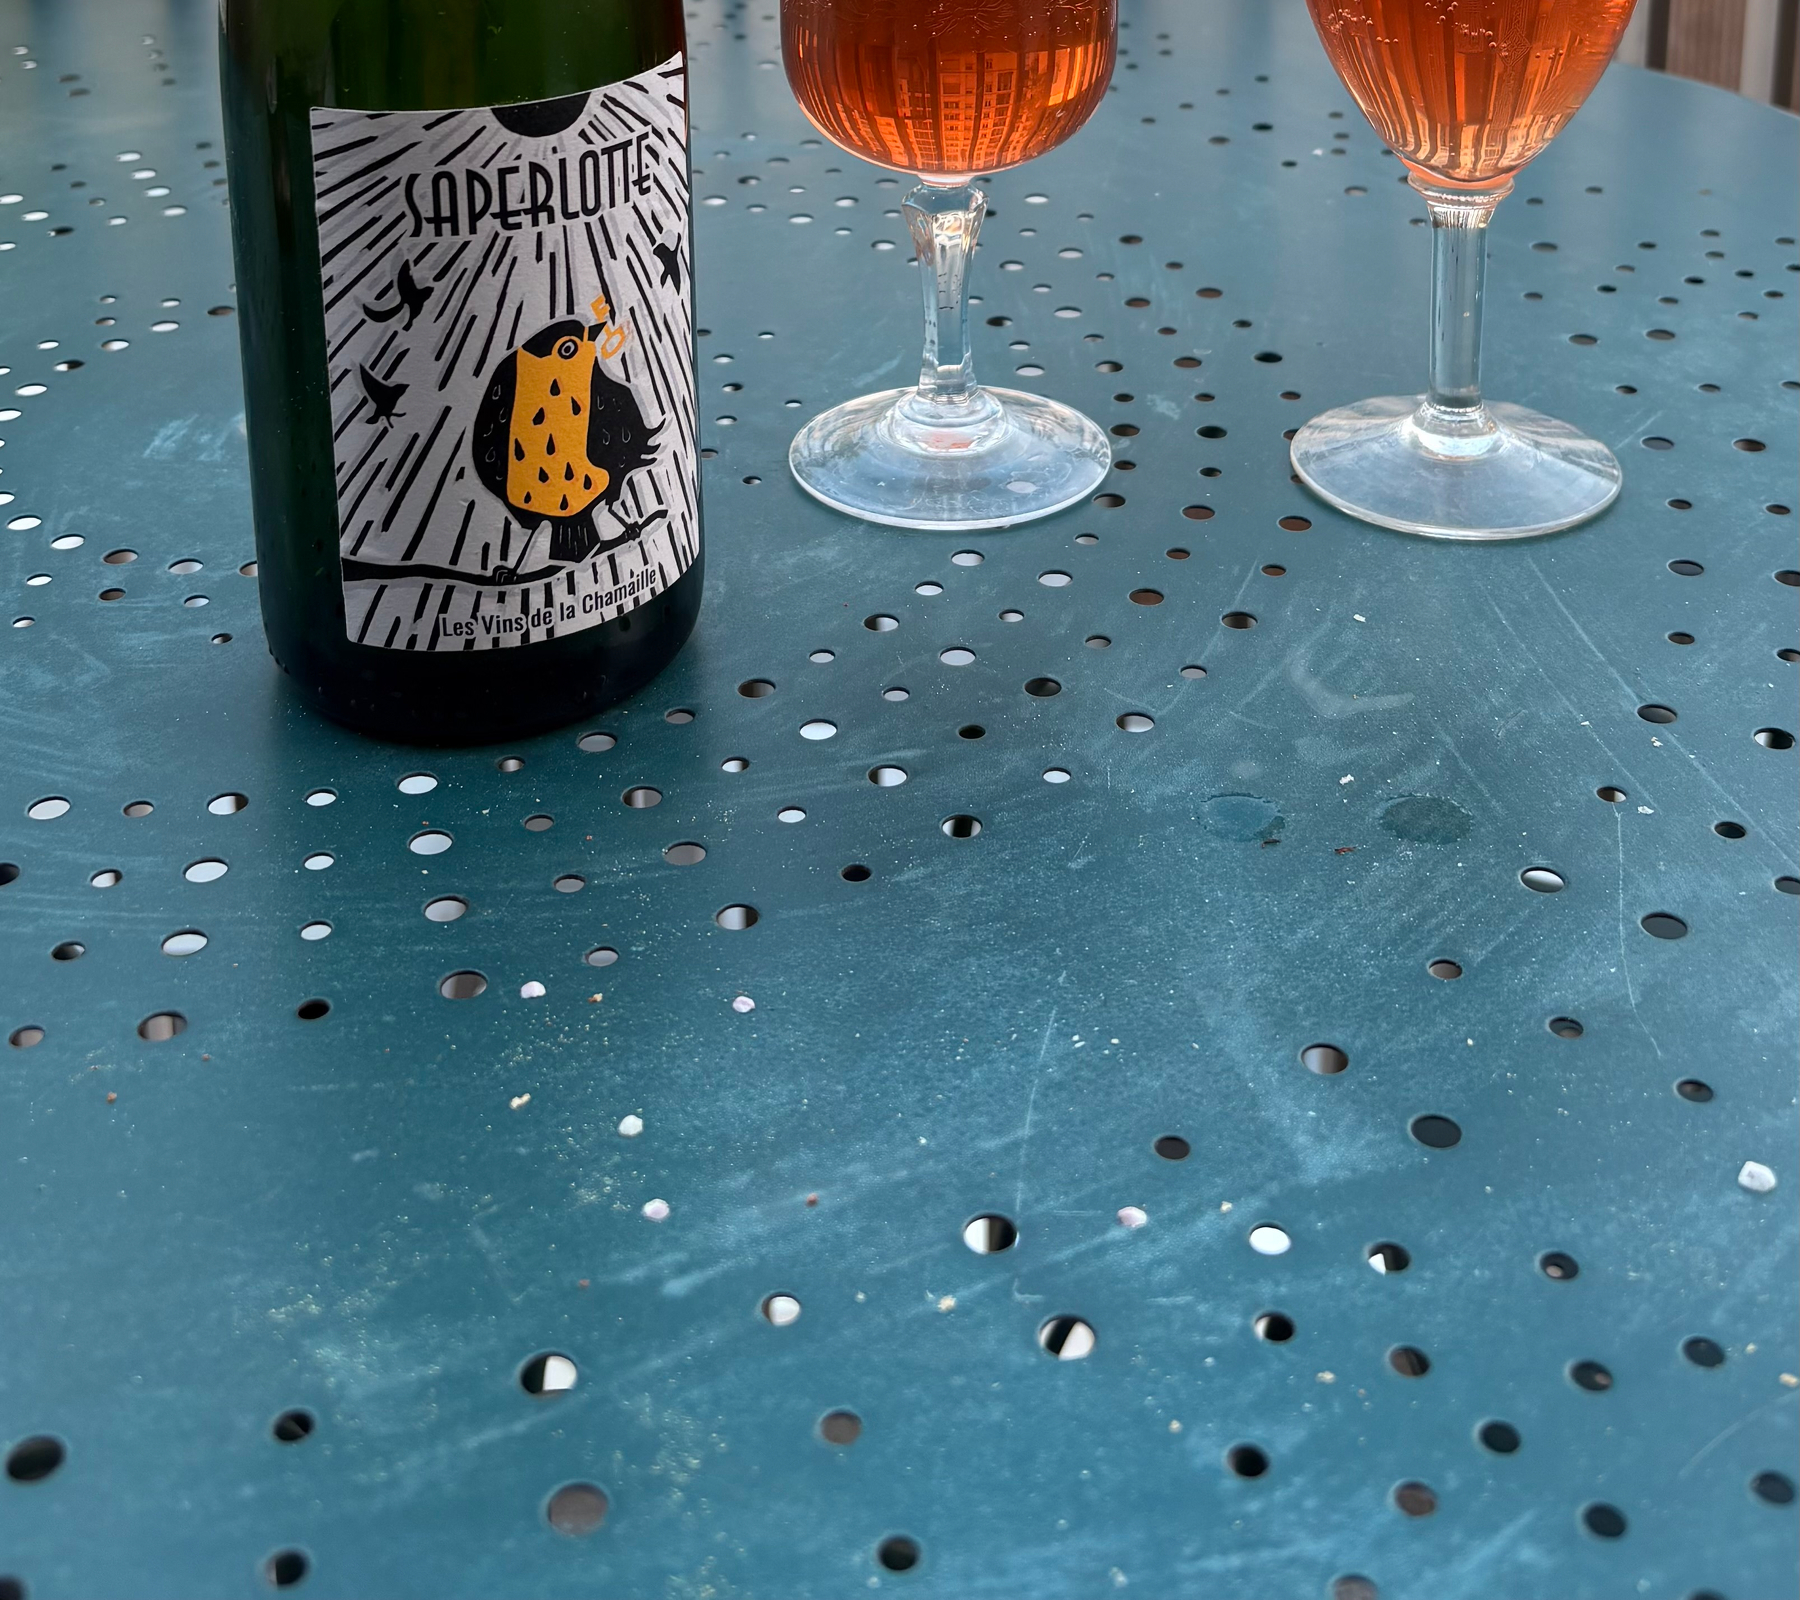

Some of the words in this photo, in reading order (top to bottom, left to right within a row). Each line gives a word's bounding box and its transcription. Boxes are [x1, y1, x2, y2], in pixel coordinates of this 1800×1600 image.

[404, 131, 651, 238] SAPERLOTTE
[442, 617, 475, 638] Les
[481, 614, 524, 635] Vins
[530, 608, 553, 629] de
[559, 602, 576, 622] la
[582, 568, 657, 614] Chamaille
